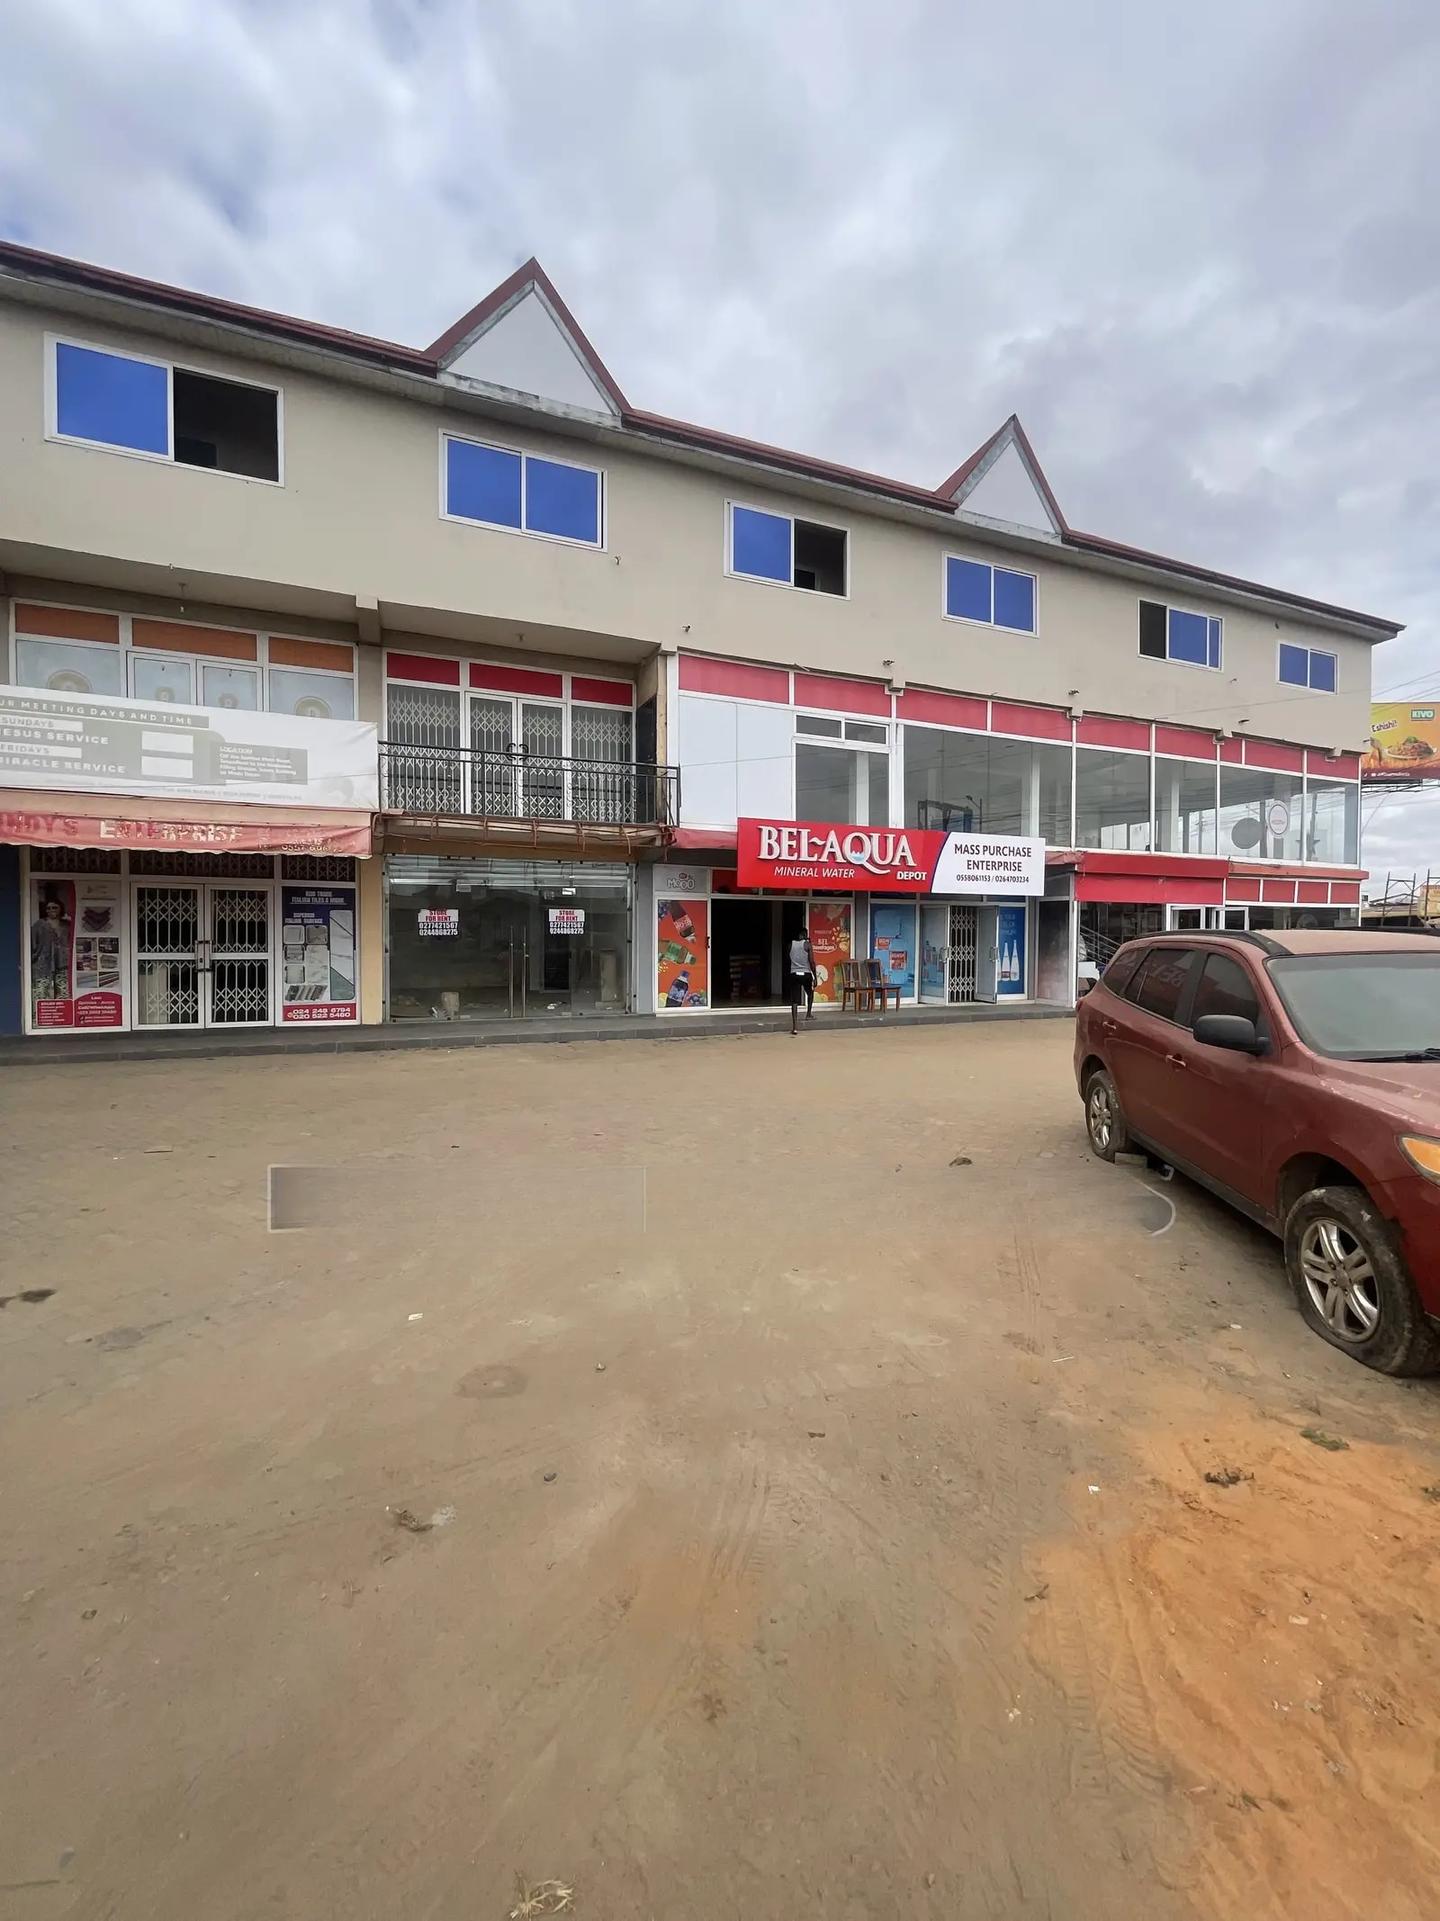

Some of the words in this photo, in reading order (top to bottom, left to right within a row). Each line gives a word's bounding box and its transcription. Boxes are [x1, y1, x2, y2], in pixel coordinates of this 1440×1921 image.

[21, 701, 85, 714] MEETING
[90, 708, 125, 718] DAYS
[130, 712, 157, 721] AND
[162, 715, 192, 725] TIME
[2, 716, 54, 727] SUNDAYS
[0, 727, 41, 739] ESUS
[47, 731, 109, 745] SERVICE
[64, 761, 126, 773] SERVICE
[954, 843, 980, 856] MASS
[982, 845, 1032, 858] PURCHASE
[966, 859, 1022, 872] ENTERPRISE
[774, 866, 819, 878] MINERAL
[822, 867, 855, 879] WATER
[896, 870, 927, 881] DEPOT
[956, 874, 991, 883] 0558061153
[995, 875, 1029, 883] 0264703234
